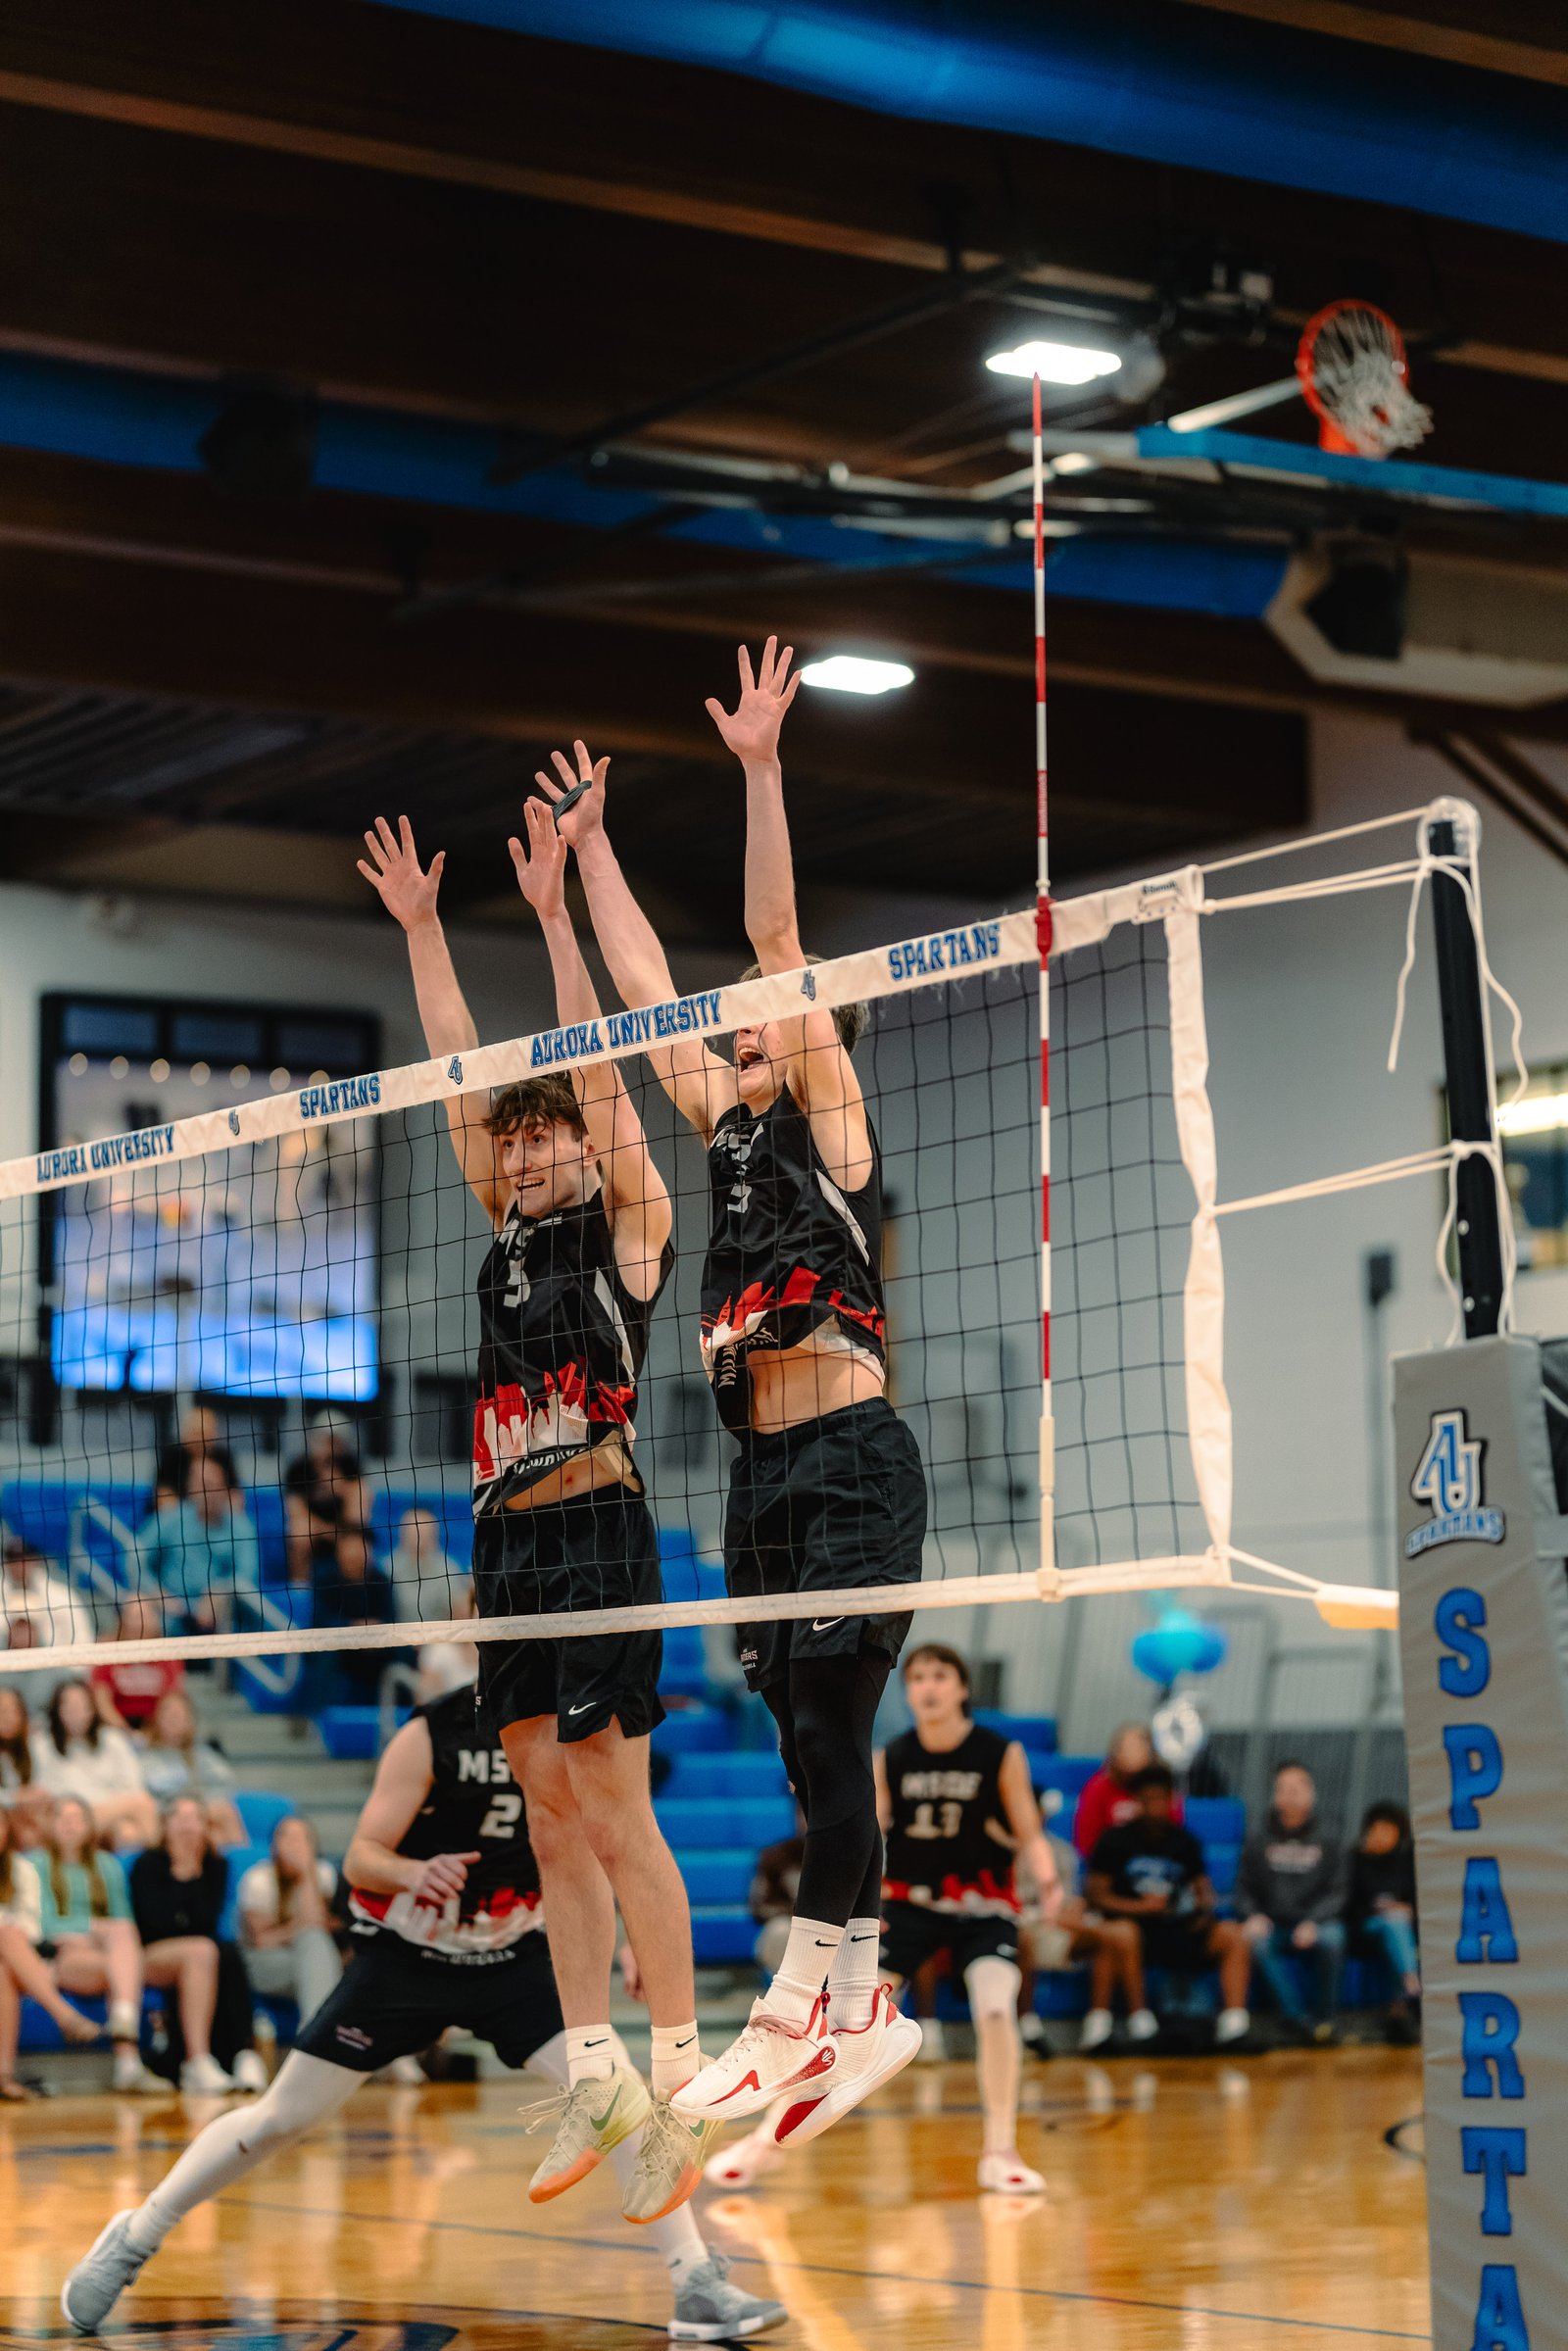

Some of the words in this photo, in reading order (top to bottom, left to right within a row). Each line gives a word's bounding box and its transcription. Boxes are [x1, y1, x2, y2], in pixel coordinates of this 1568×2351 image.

[36, 1147, 87, 1183] AURORA
[90, 1125, 174, 1170] UNIVERSITY
[299, 1073, 381, 1119] SPARTANS
[530, 1022, 605, 1068] AURORA
[607, 990, 722, 1049] UNIVERSITY
[888, 922, 1001, 982] SPARTANS
[458, 1748, 511, 1784] MS
[479, 1793, 523, 1838] 2
